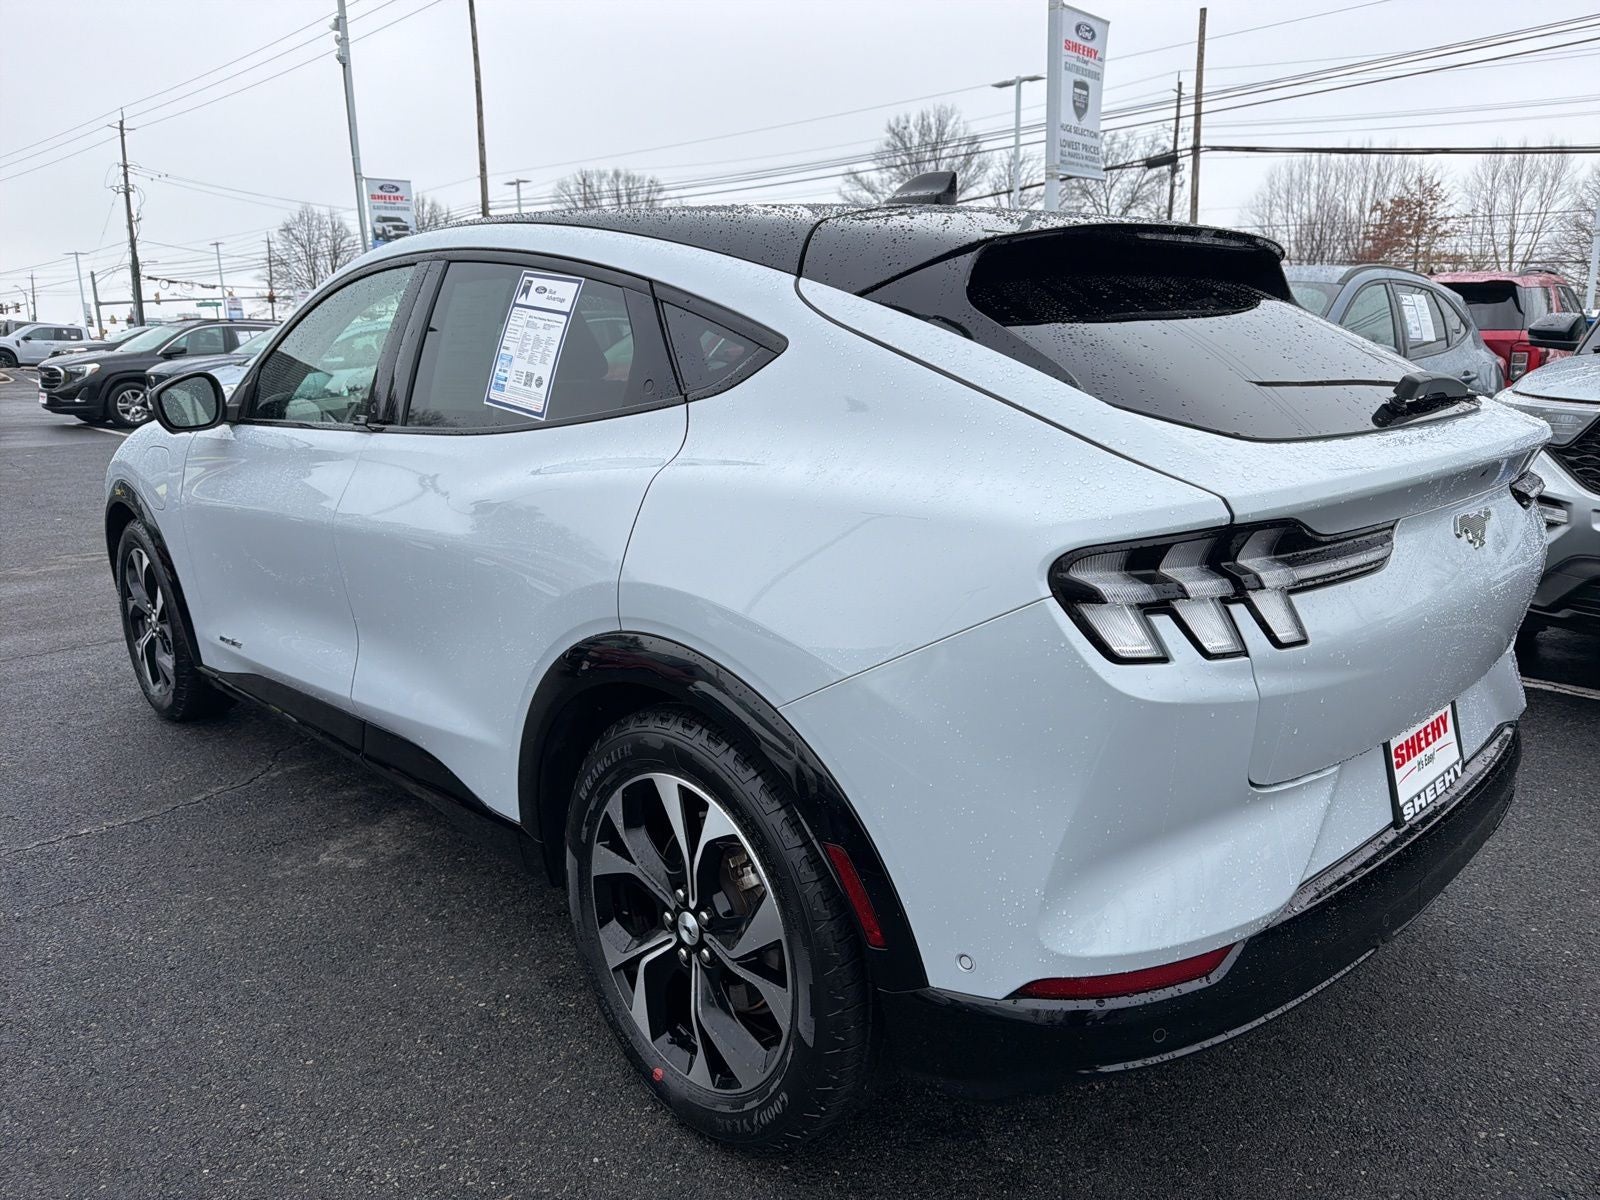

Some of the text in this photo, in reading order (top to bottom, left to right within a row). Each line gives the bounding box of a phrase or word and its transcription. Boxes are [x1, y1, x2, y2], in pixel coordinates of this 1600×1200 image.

[1064, 39, 1098, 61] SHEEHY
[1077, 23, 1094, 40] Ford
[1060, 138, 1099, 155] LOWEST PRICES
[1394, 710, 1449, 770] SHEEHY
[579, 742, 633, 801] WRANGLER
[1402, 760, 1463, 822] SHEEHY
